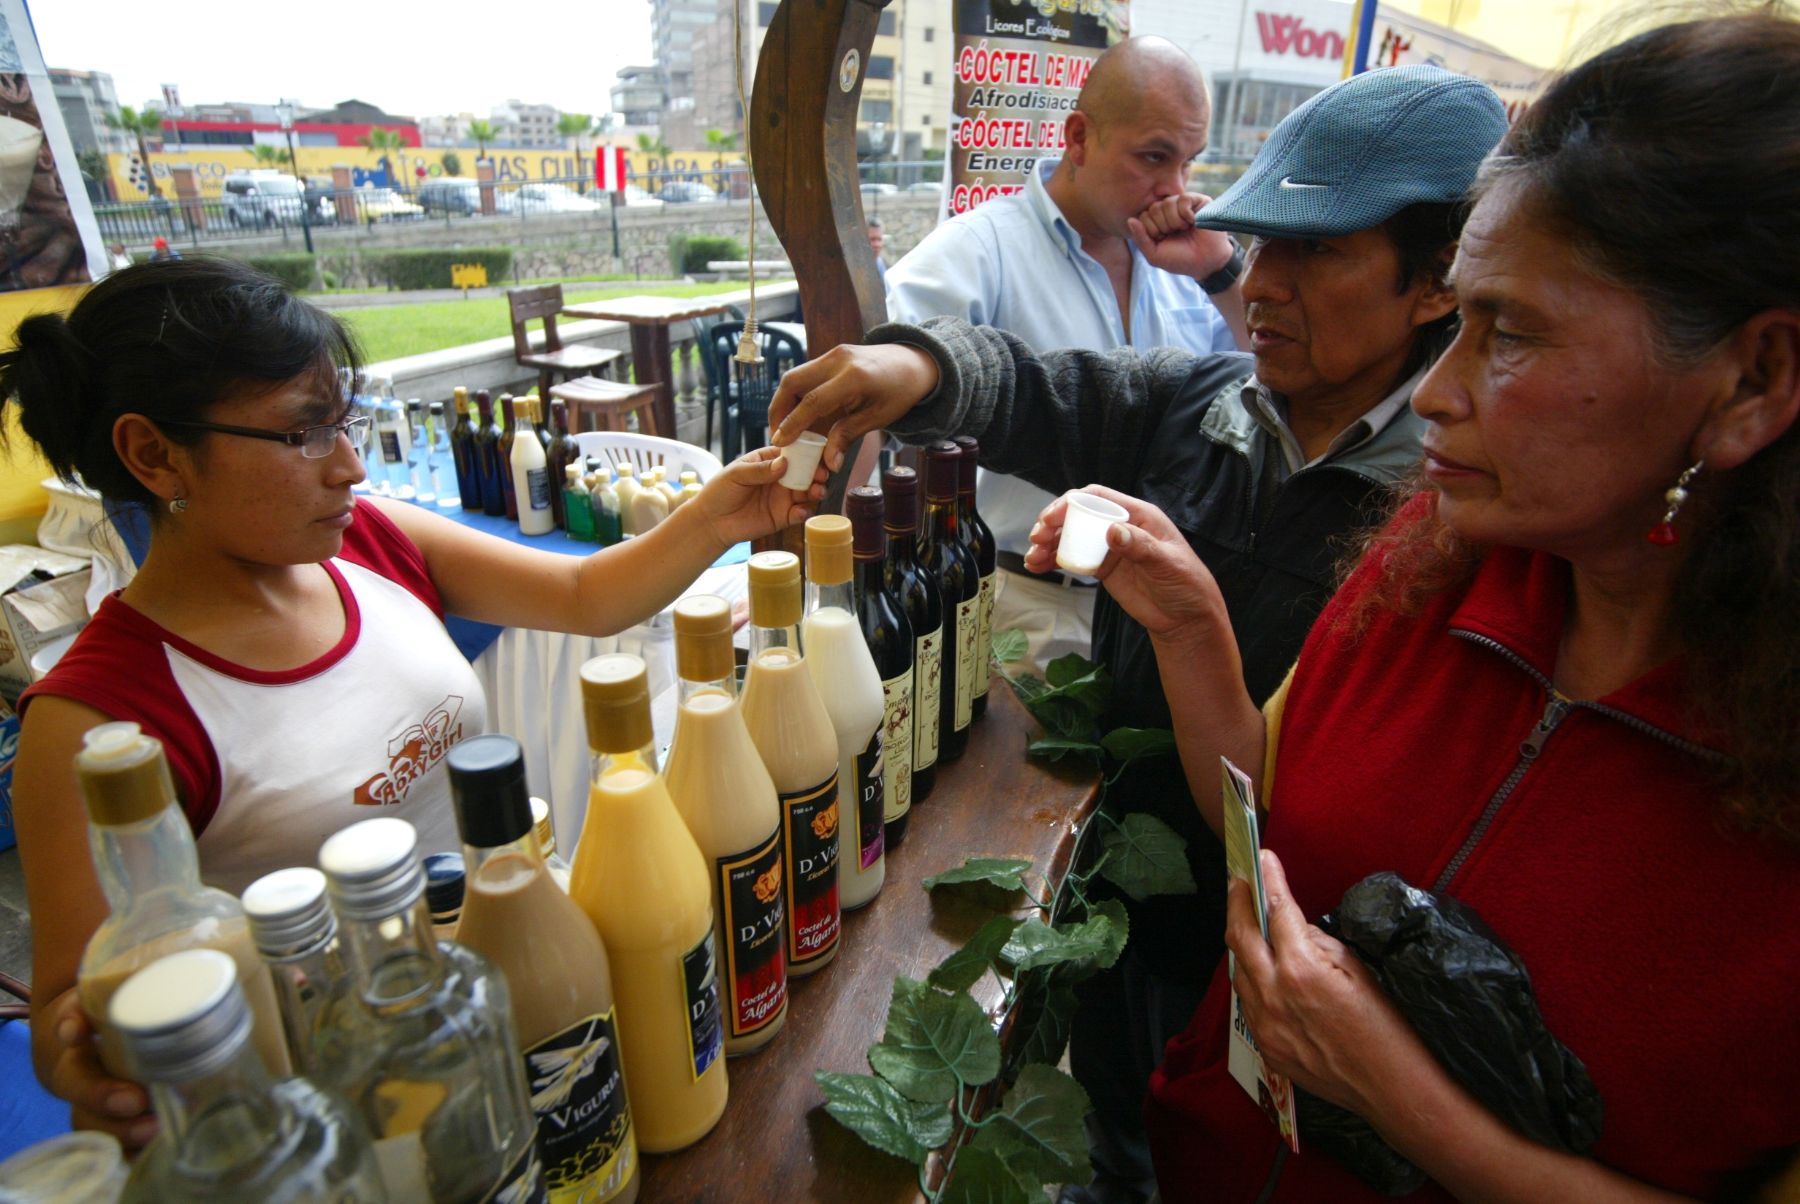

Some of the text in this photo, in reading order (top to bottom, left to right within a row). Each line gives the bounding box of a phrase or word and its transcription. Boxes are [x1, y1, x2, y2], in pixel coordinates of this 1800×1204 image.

[986, 14, 1025, 34] Licores
[1256, 12, 1344, 60] Won
[1045, 54, 1065, 87] DE
[1066, 57, 1096, 89] MA
[1037, 122, 1055, 149] DE
